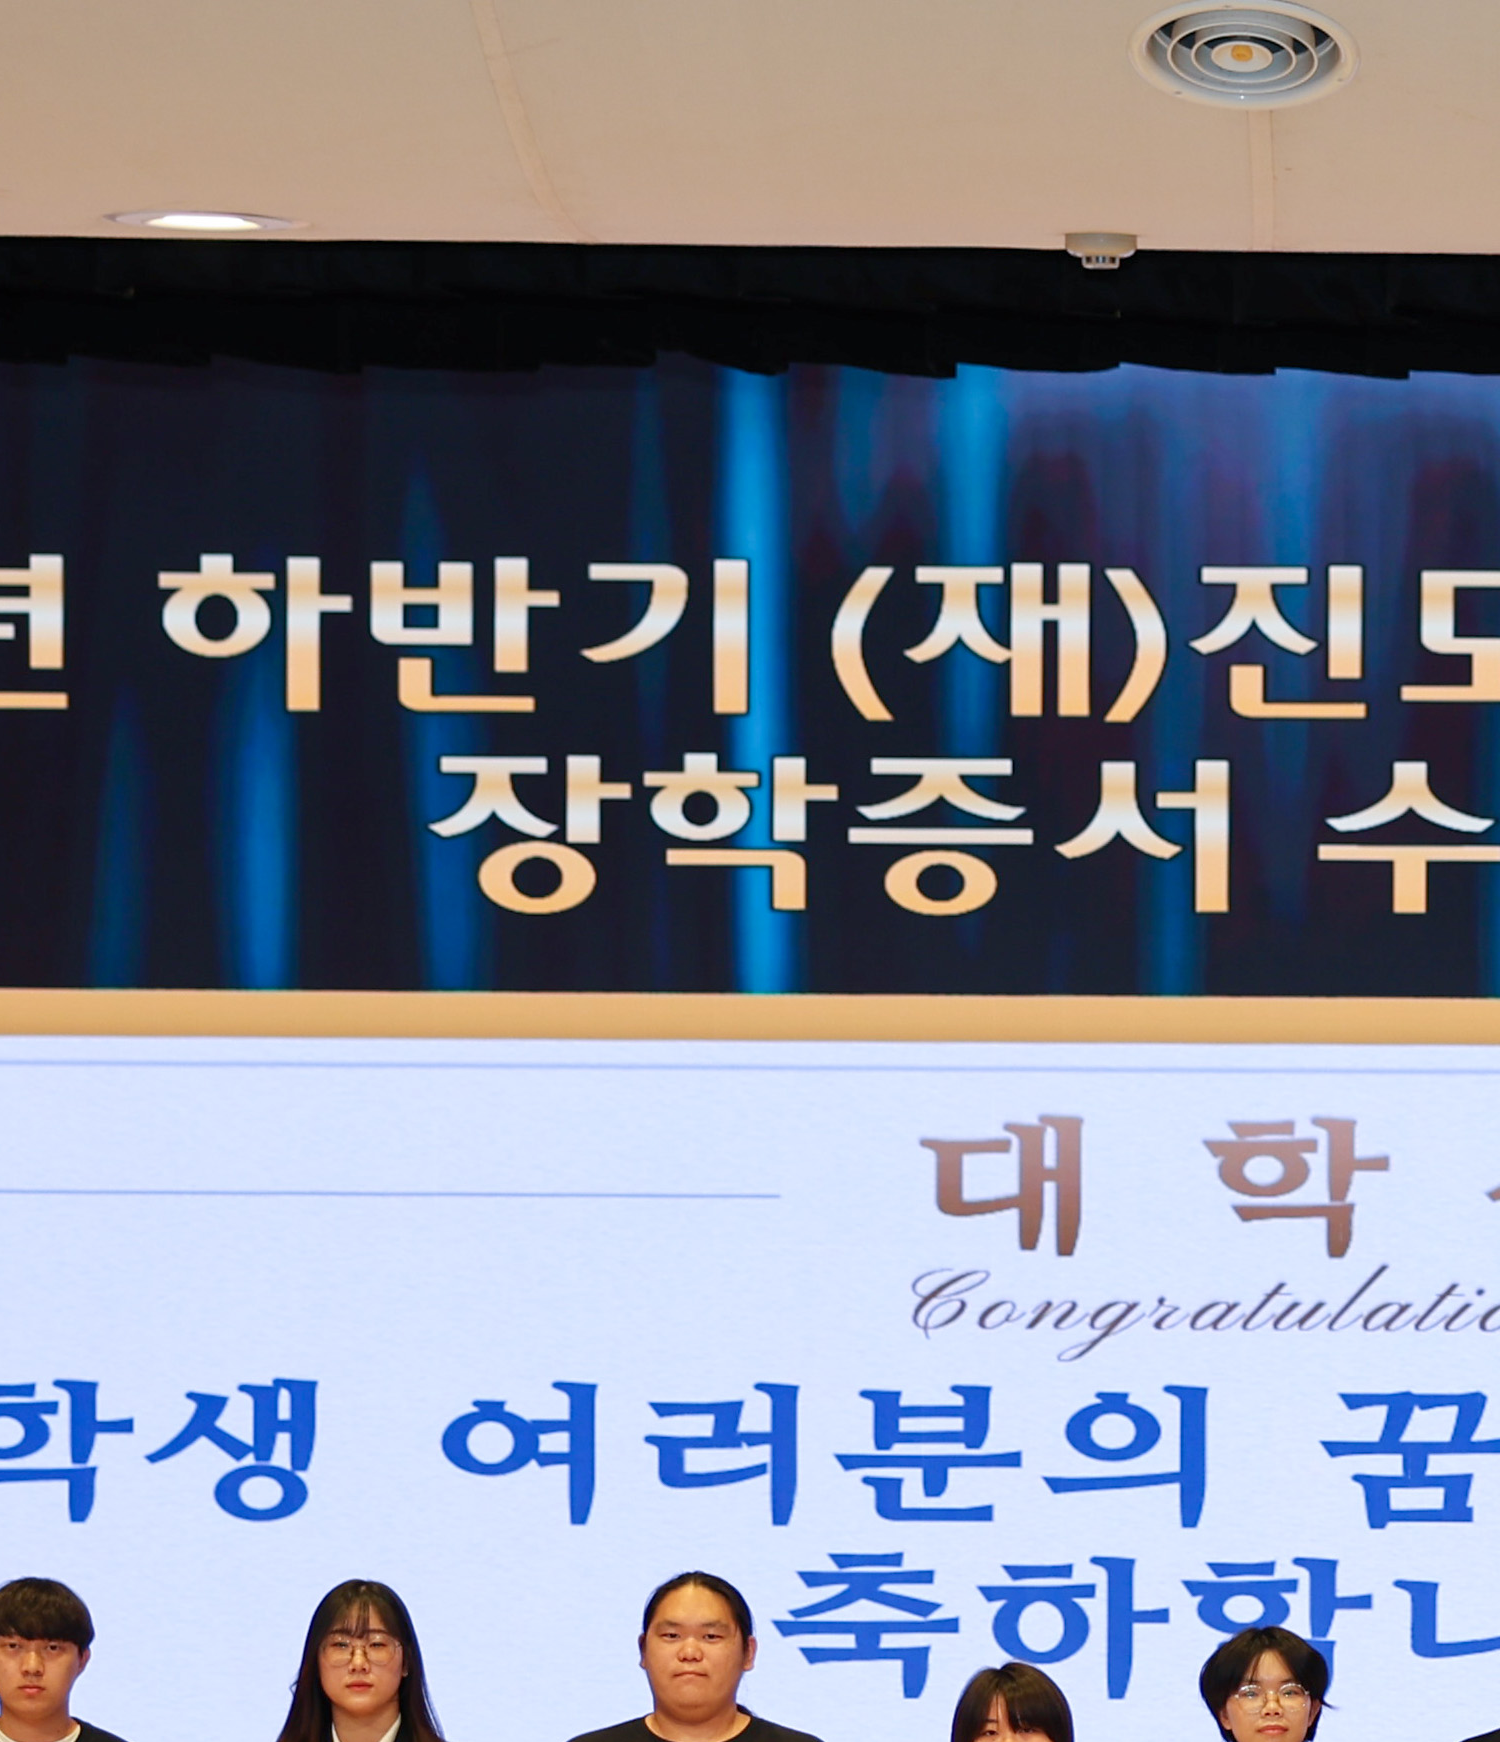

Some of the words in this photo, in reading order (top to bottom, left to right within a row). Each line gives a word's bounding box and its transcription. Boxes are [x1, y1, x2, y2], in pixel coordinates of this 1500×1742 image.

[157, 553, 750, 714] 하반기
[427, 753, 1231, 917] 장학증서
[440, 1379, 1210, 1530] 여러분의
